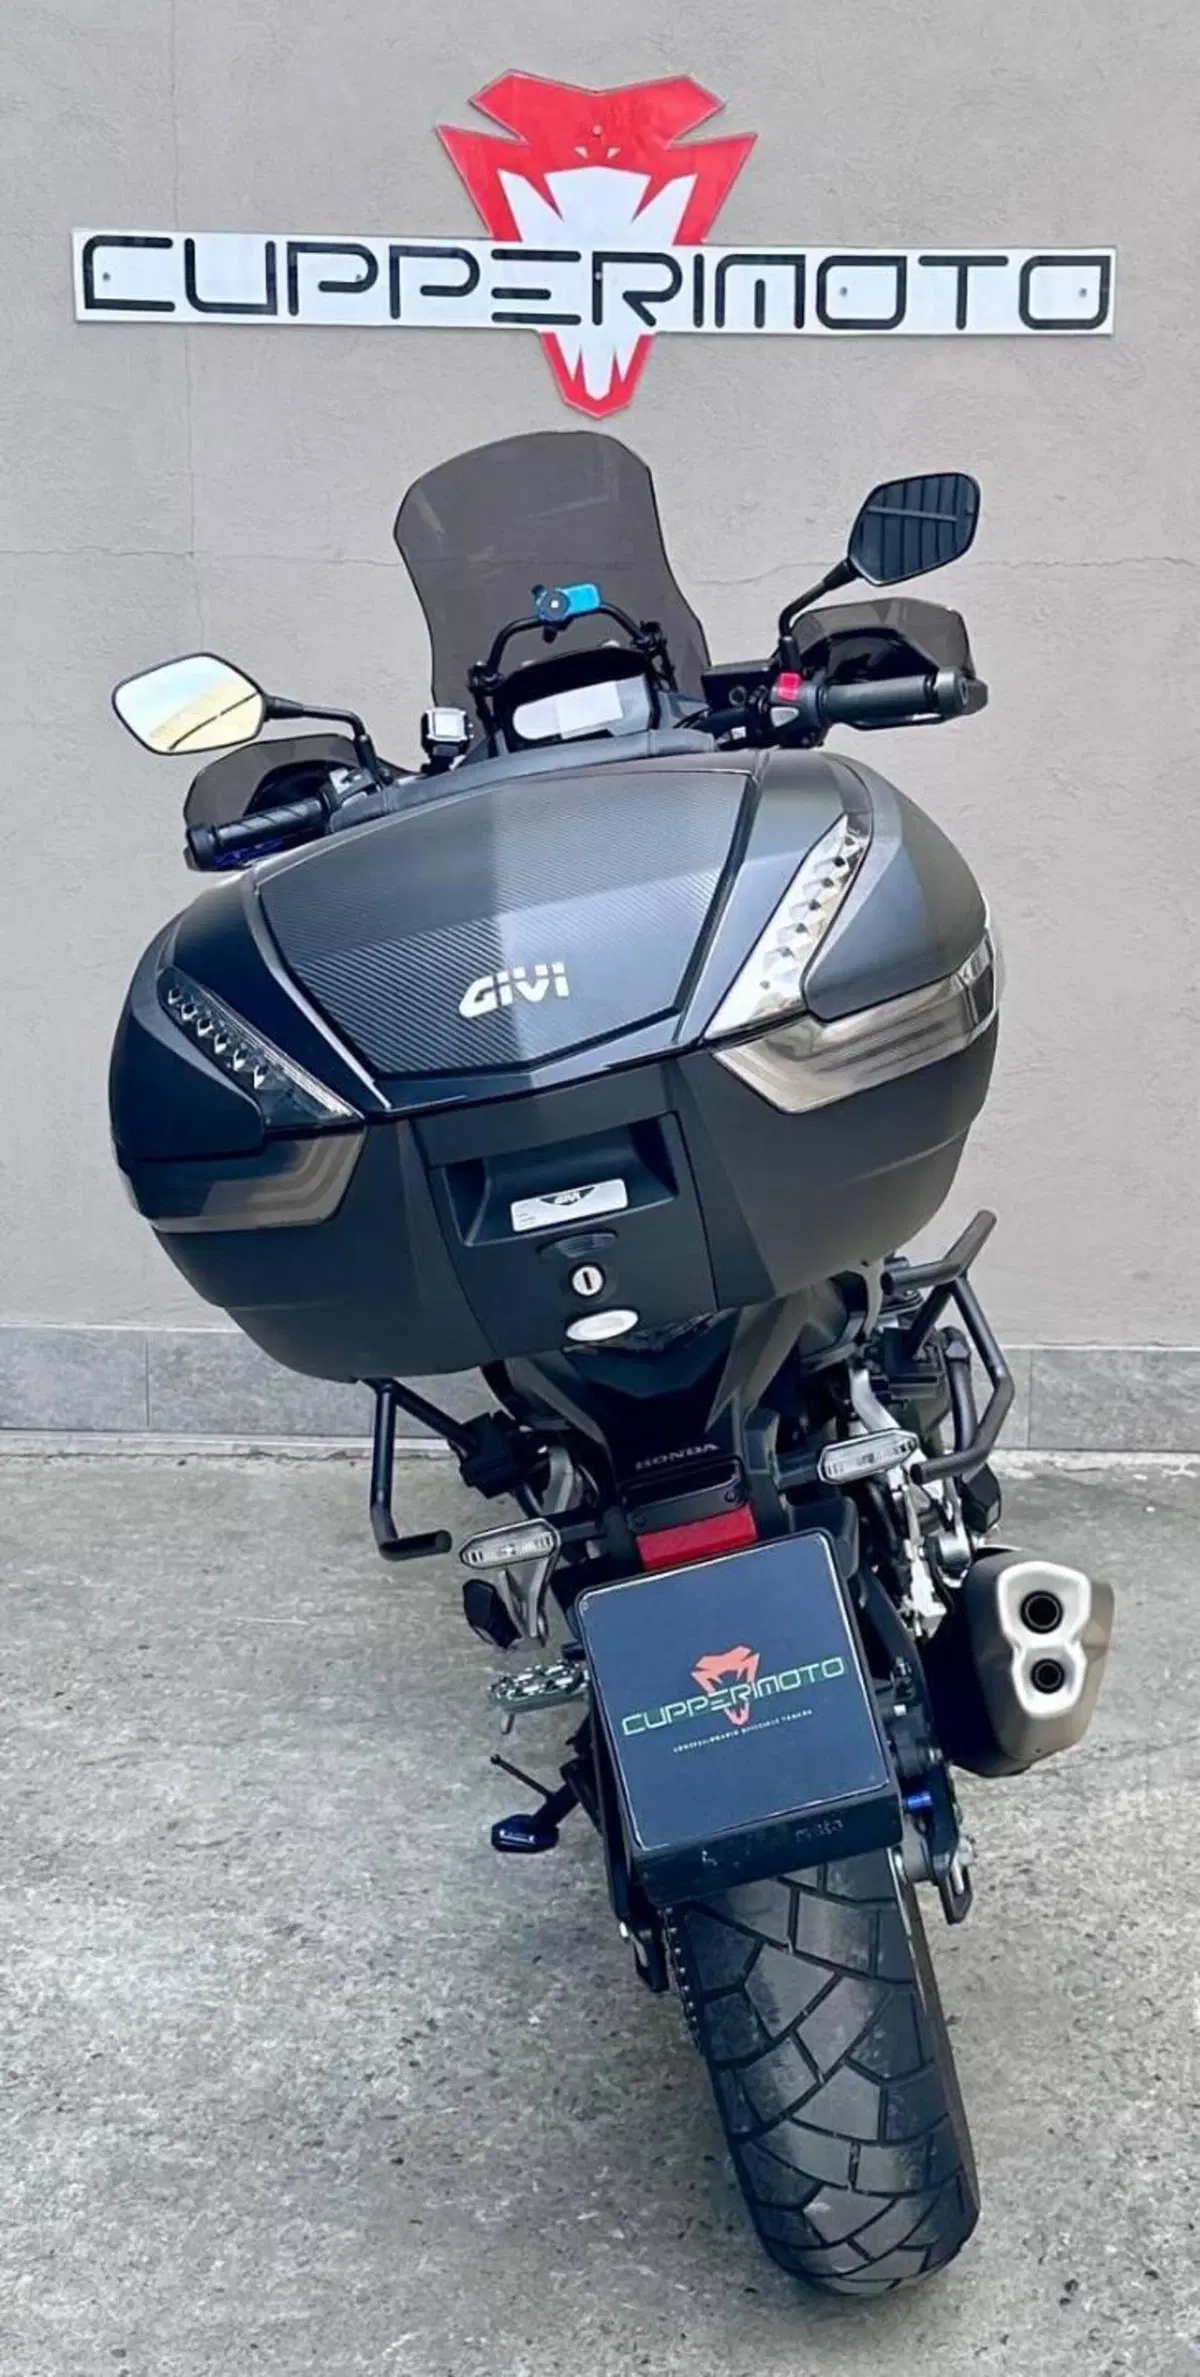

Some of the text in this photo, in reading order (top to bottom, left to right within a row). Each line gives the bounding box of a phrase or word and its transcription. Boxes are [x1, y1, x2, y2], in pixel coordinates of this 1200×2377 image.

[82, 235, 1111, 331] CUPPERIMOTO
[458, 961, 570, 1018] GIVI
[635, 1443, 719, 1471] HONDA
[620, 1656, 845, 1736] CUPPERIMOTO
